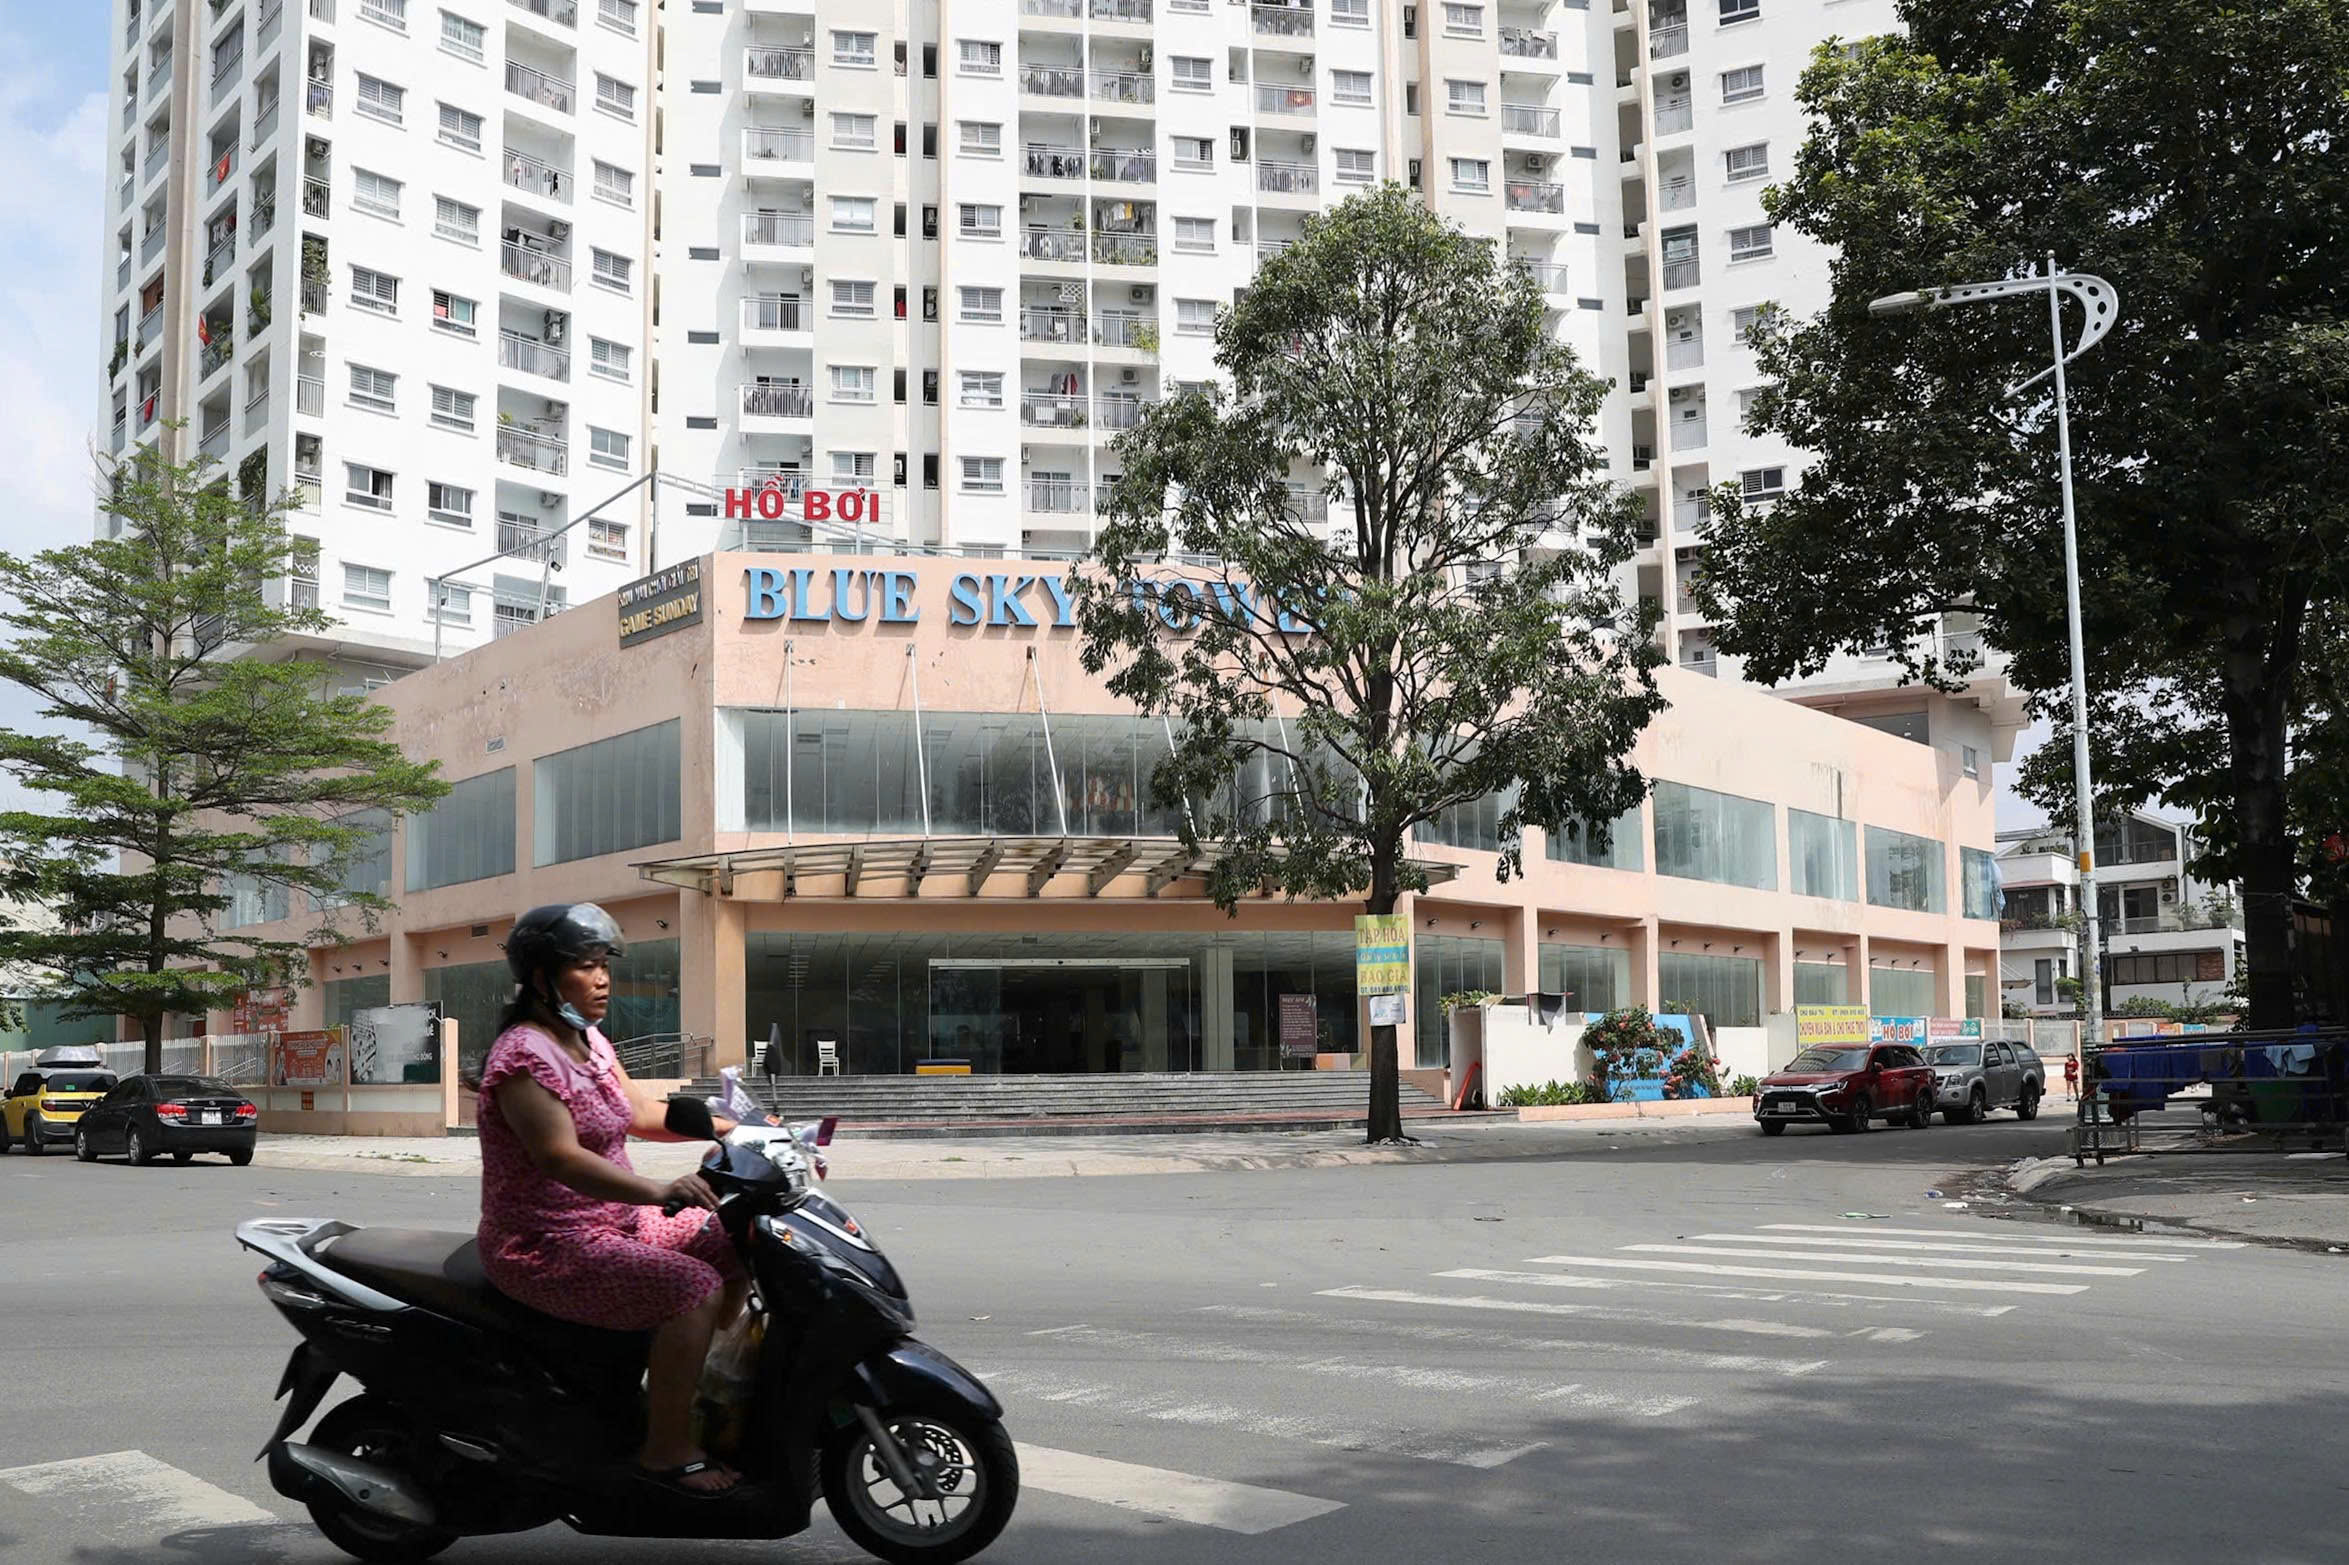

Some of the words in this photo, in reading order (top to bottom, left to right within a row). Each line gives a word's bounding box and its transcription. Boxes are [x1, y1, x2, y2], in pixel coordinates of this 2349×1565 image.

[725, 475, 785, 520] HỒ
[803, 488, 879, 523] BƠI
[619, 609, 653, 638] GAME
[653, 591, 699, 626] SUNDAY
[743, 567, 921, 623] BLUE
[950, 573, 1078, 628] SKY
